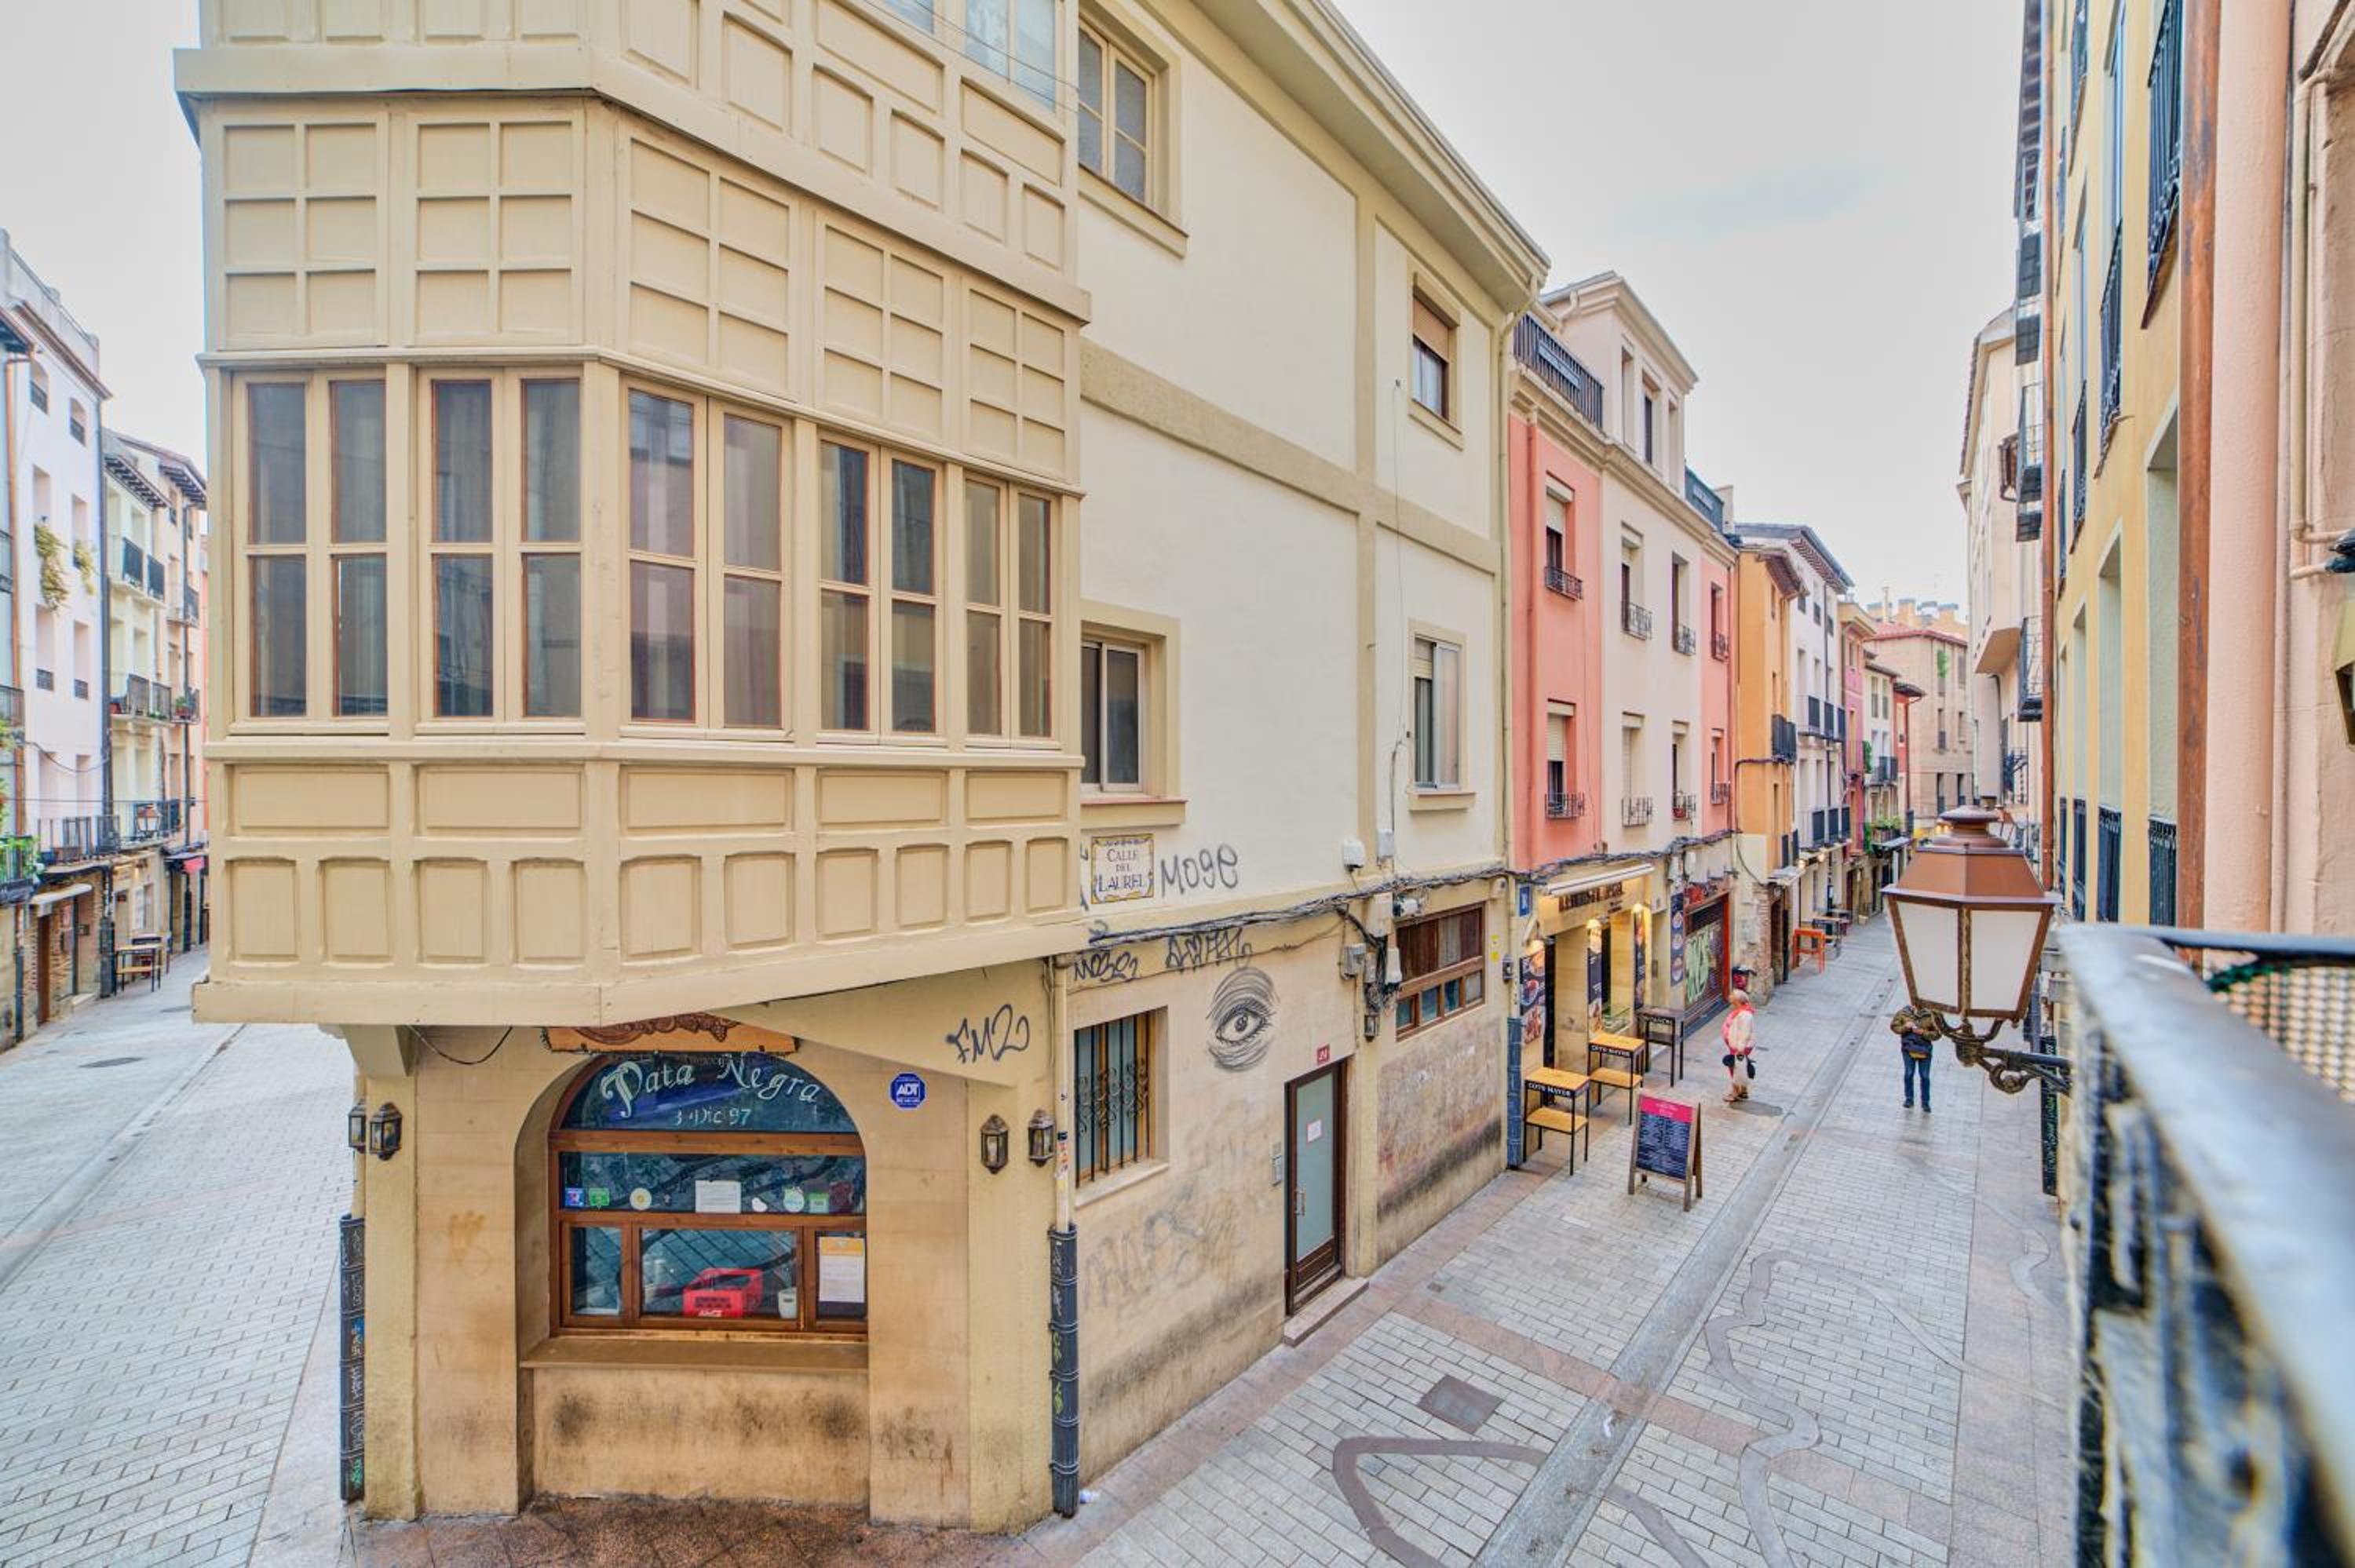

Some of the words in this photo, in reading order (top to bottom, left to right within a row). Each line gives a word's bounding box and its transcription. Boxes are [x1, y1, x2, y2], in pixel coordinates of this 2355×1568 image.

[1098, 873, 1145, 892] LAUREL
[600, 1059, 696, 1118] Pata
[717, 1051, 822, 1103] Negra
[896, 1083, 920, 1096] ADT
